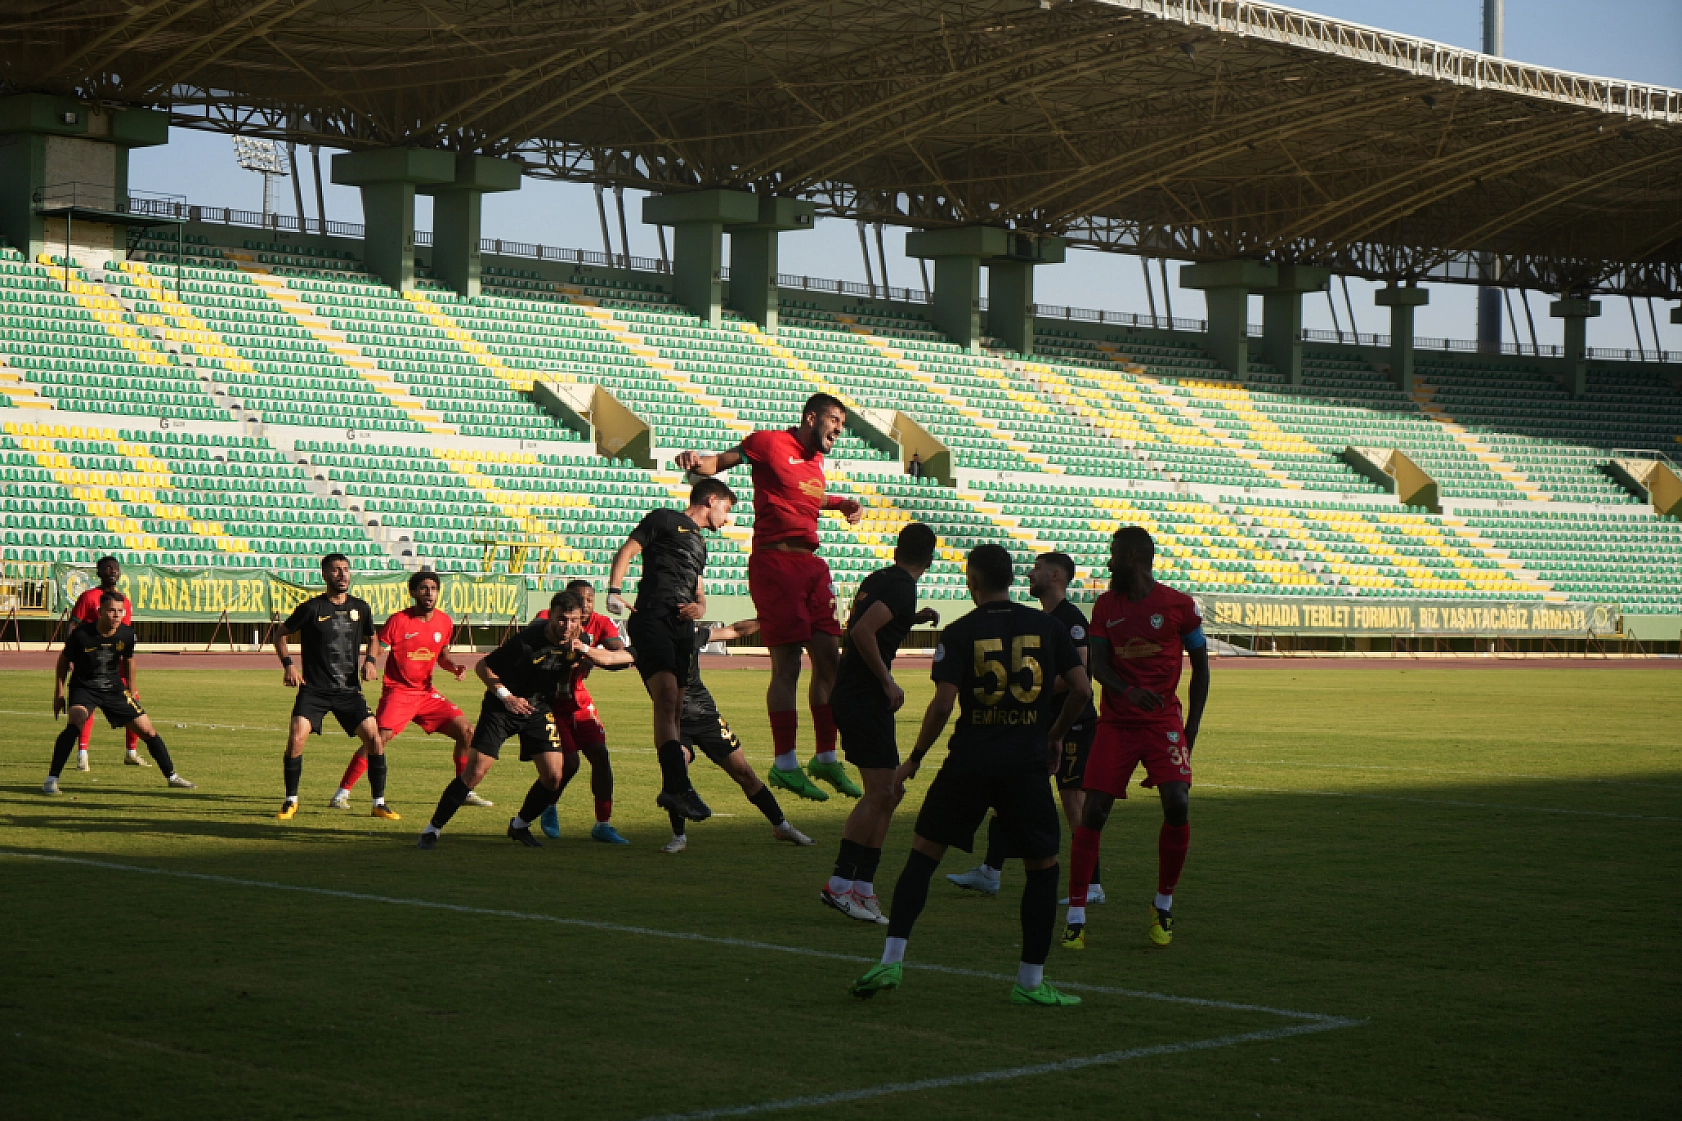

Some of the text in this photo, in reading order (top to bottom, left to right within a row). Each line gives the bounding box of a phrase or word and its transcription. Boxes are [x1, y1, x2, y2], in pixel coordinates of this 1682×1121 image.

[137, 571, 265, 613] FANATİKLER
[451, 574, 518, 615] ÖLÜRÜZ
[1214, 601, 1242, 625] SEN
[1245, 602, 1300, 627] SAHADA
[1302, 604, 1351, 627] TERLET
[1441, 604, 1529, 632] YAŞATACAĞIZ
[973, 633, 1044, 707] 55
[972, 706, 1038, 725] EMİRCAN
[1065, 756, 1078, 776] 7
